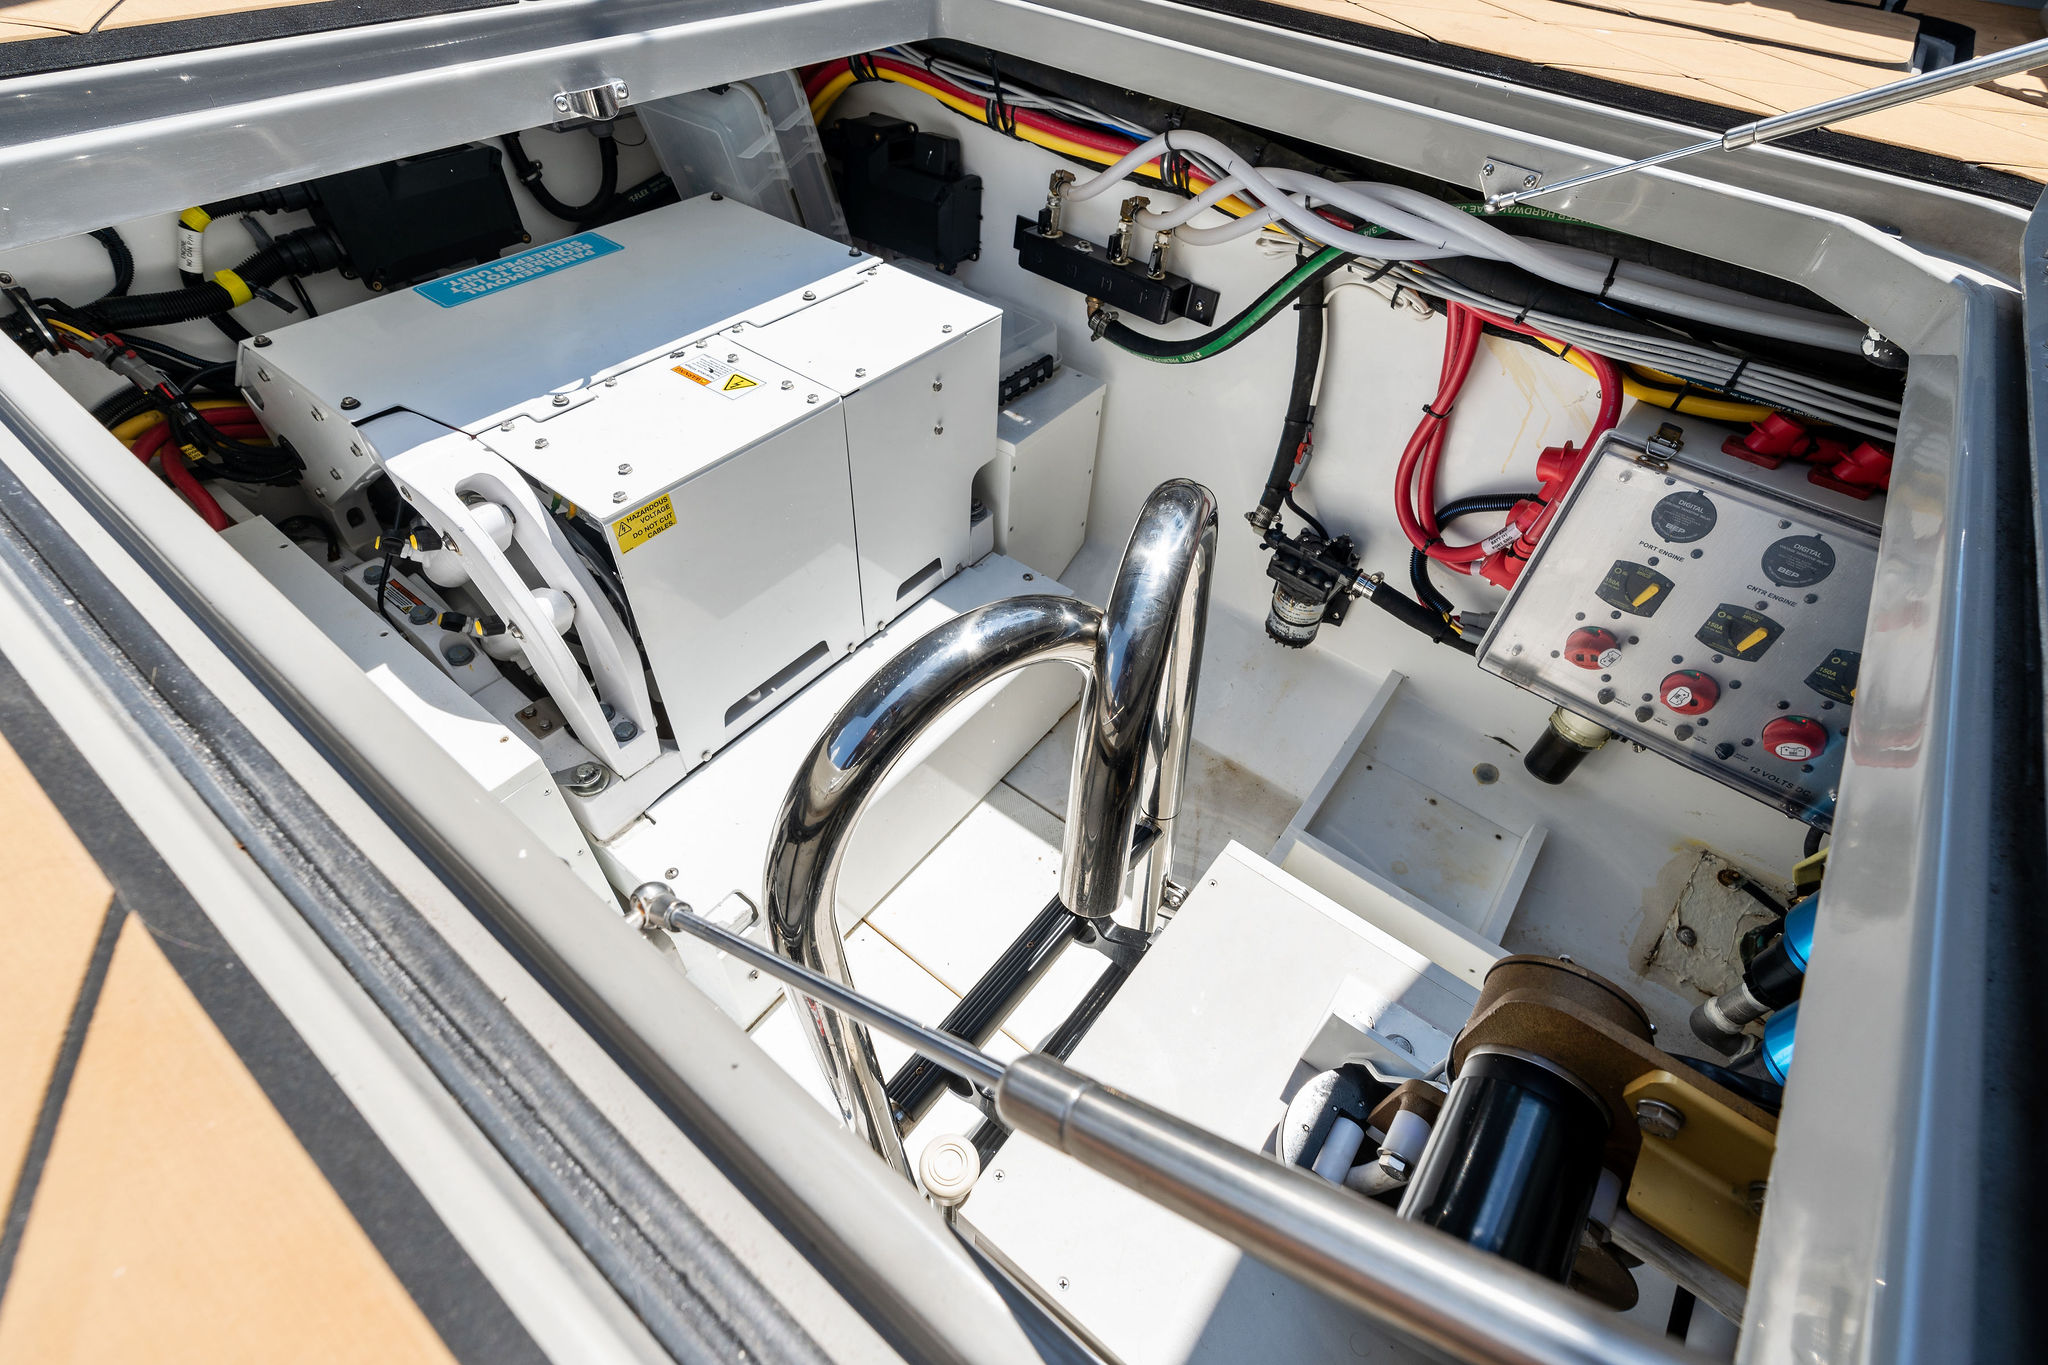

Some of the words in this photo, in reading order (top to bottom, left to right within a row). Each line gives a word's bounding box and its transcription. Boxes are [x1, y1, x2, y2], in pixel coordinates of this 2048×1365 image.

[491, 240, 583, 272] SEAKEEPER
[511, 243, 593, 273] REQUIRED
[546, 249, 596, 269] PANEL
[442, 270, 490, 288] UNIT.
[449, 278, 487, 295] LIFT
[463, 266, 546, 295] REMOVAL
[486, 270, 513, 283] TO
[626, 496, 669, 524] HAZARDOUS
[640, 503, 671, 524] VOLTAGE
[1678, 499, 1704, 514] DIGITAL
[632, 530, 643, 539] DO
[644, 520, 659, 533] NOT
[659, 511, 673, 524] CUT
[1665, 523, 1686, 533] BEP
[1639, 540, 1658, 551] PORT
[1659, 549, 1685, 563] ENGINE
[1793, 543, 1823, 559] DIGITAL
[1777, 566, 1800, 578] BEP
[1746, 584, 1768, 596] CNTR
[1768, 592, 1798, 608] ENGINE
[1707, 621, 1723, 631] 150A
[1819, 666, 1837, 677] 150A
[1749, 766, 1761, 775] 12
[1762, 771, 1794, 789] VOLTS
